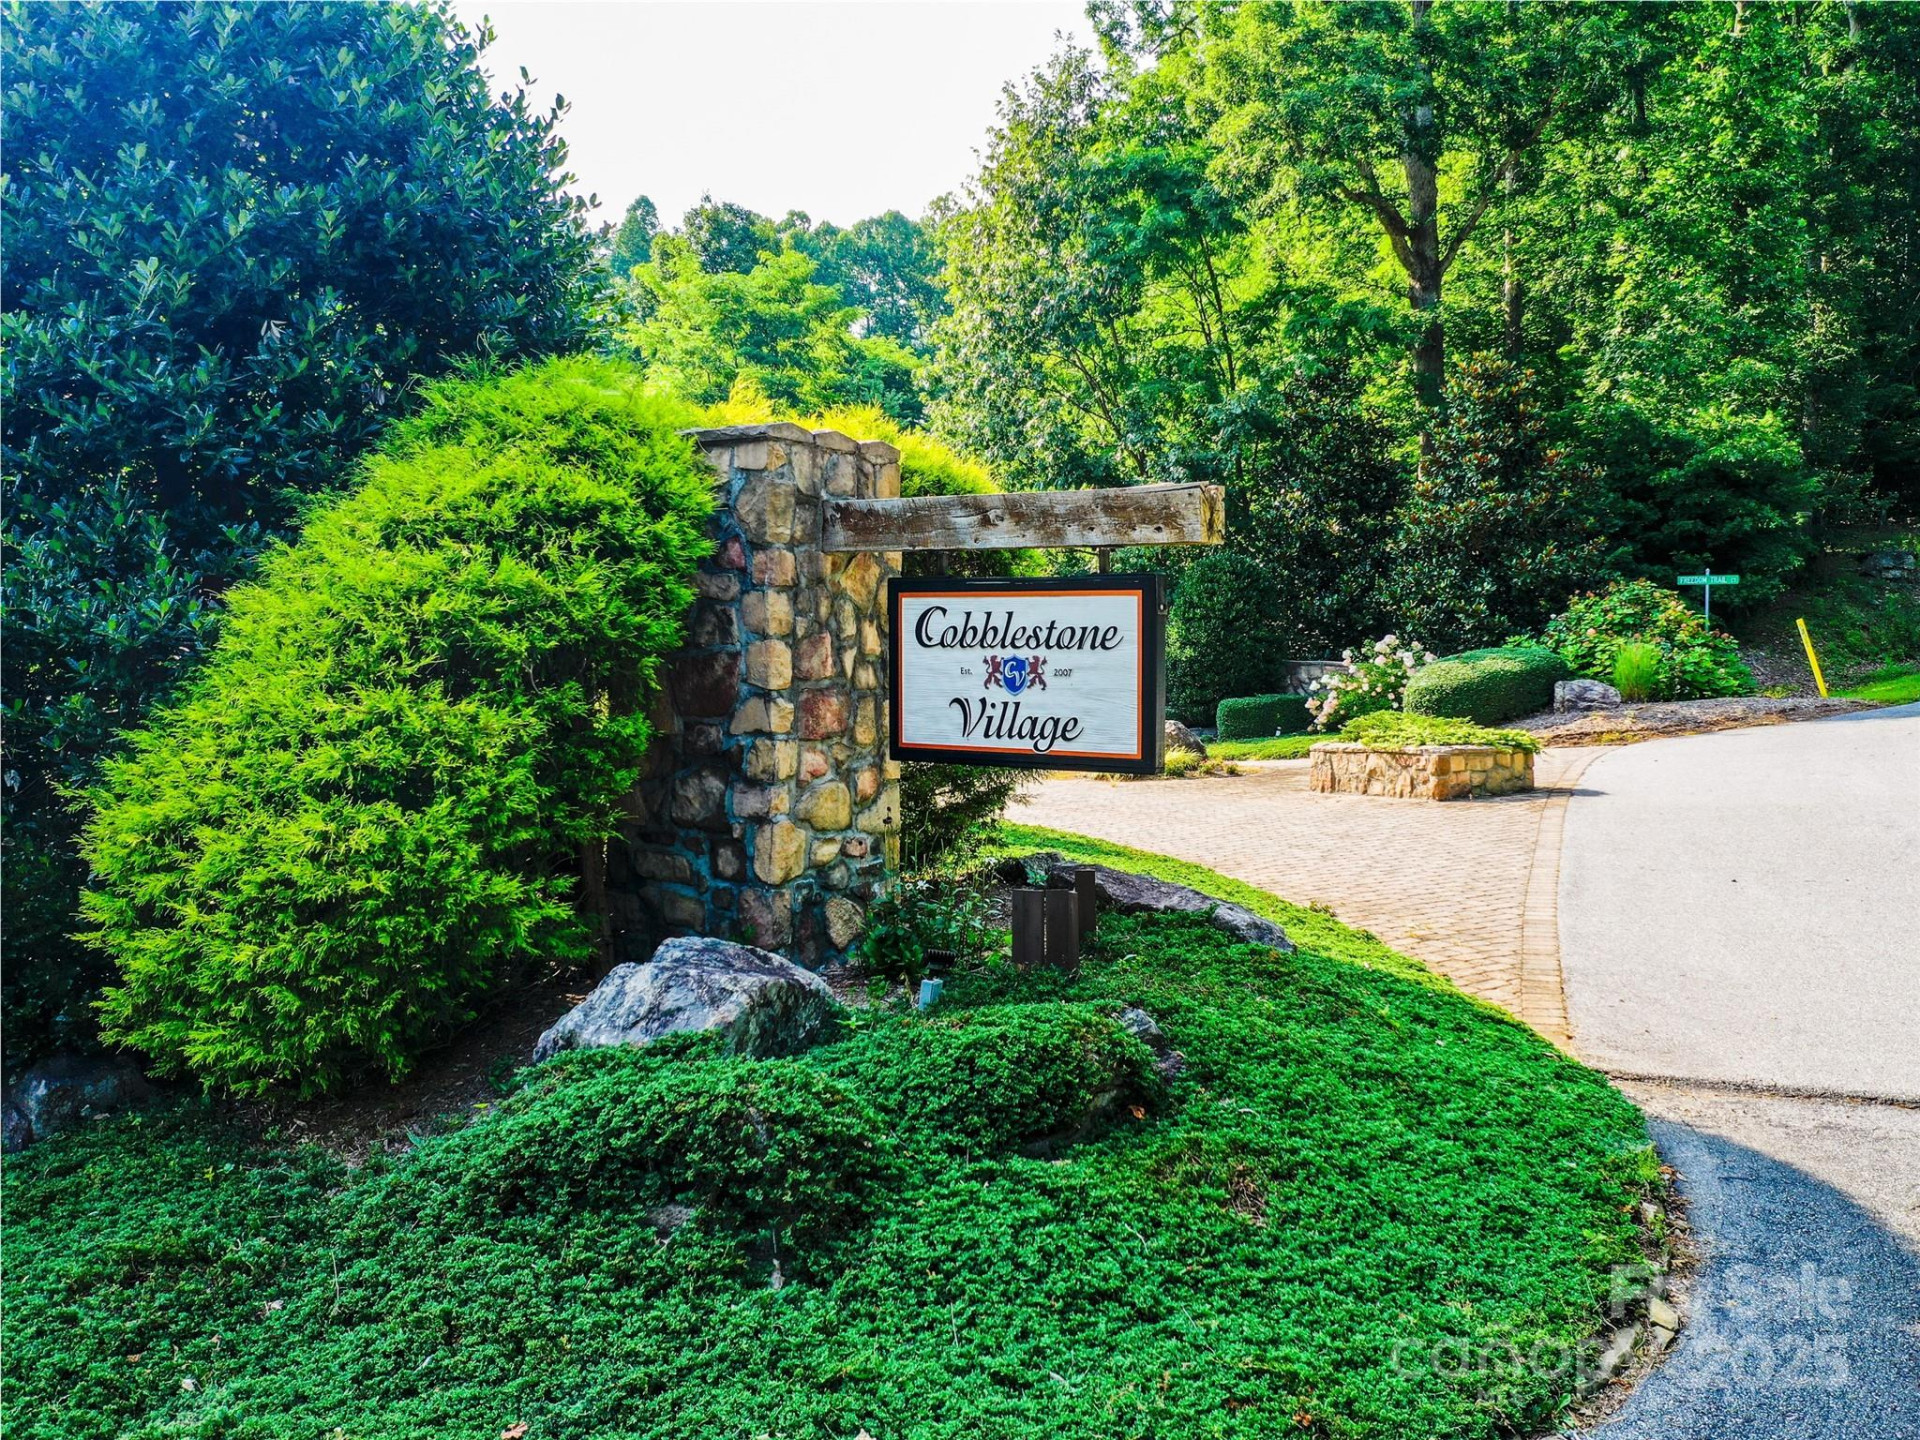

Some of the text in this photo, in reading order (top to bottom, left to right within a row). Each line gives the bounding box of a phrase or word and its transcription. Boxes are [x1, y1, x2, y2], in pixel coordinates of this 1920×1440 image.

[1710, 576, 1727, 584] TRAIL
[914, 605, 1124, 651] Cobblestone
[960, 666, 1073, 678] Est. 2007
[949, 696, 1084, 753] Village
